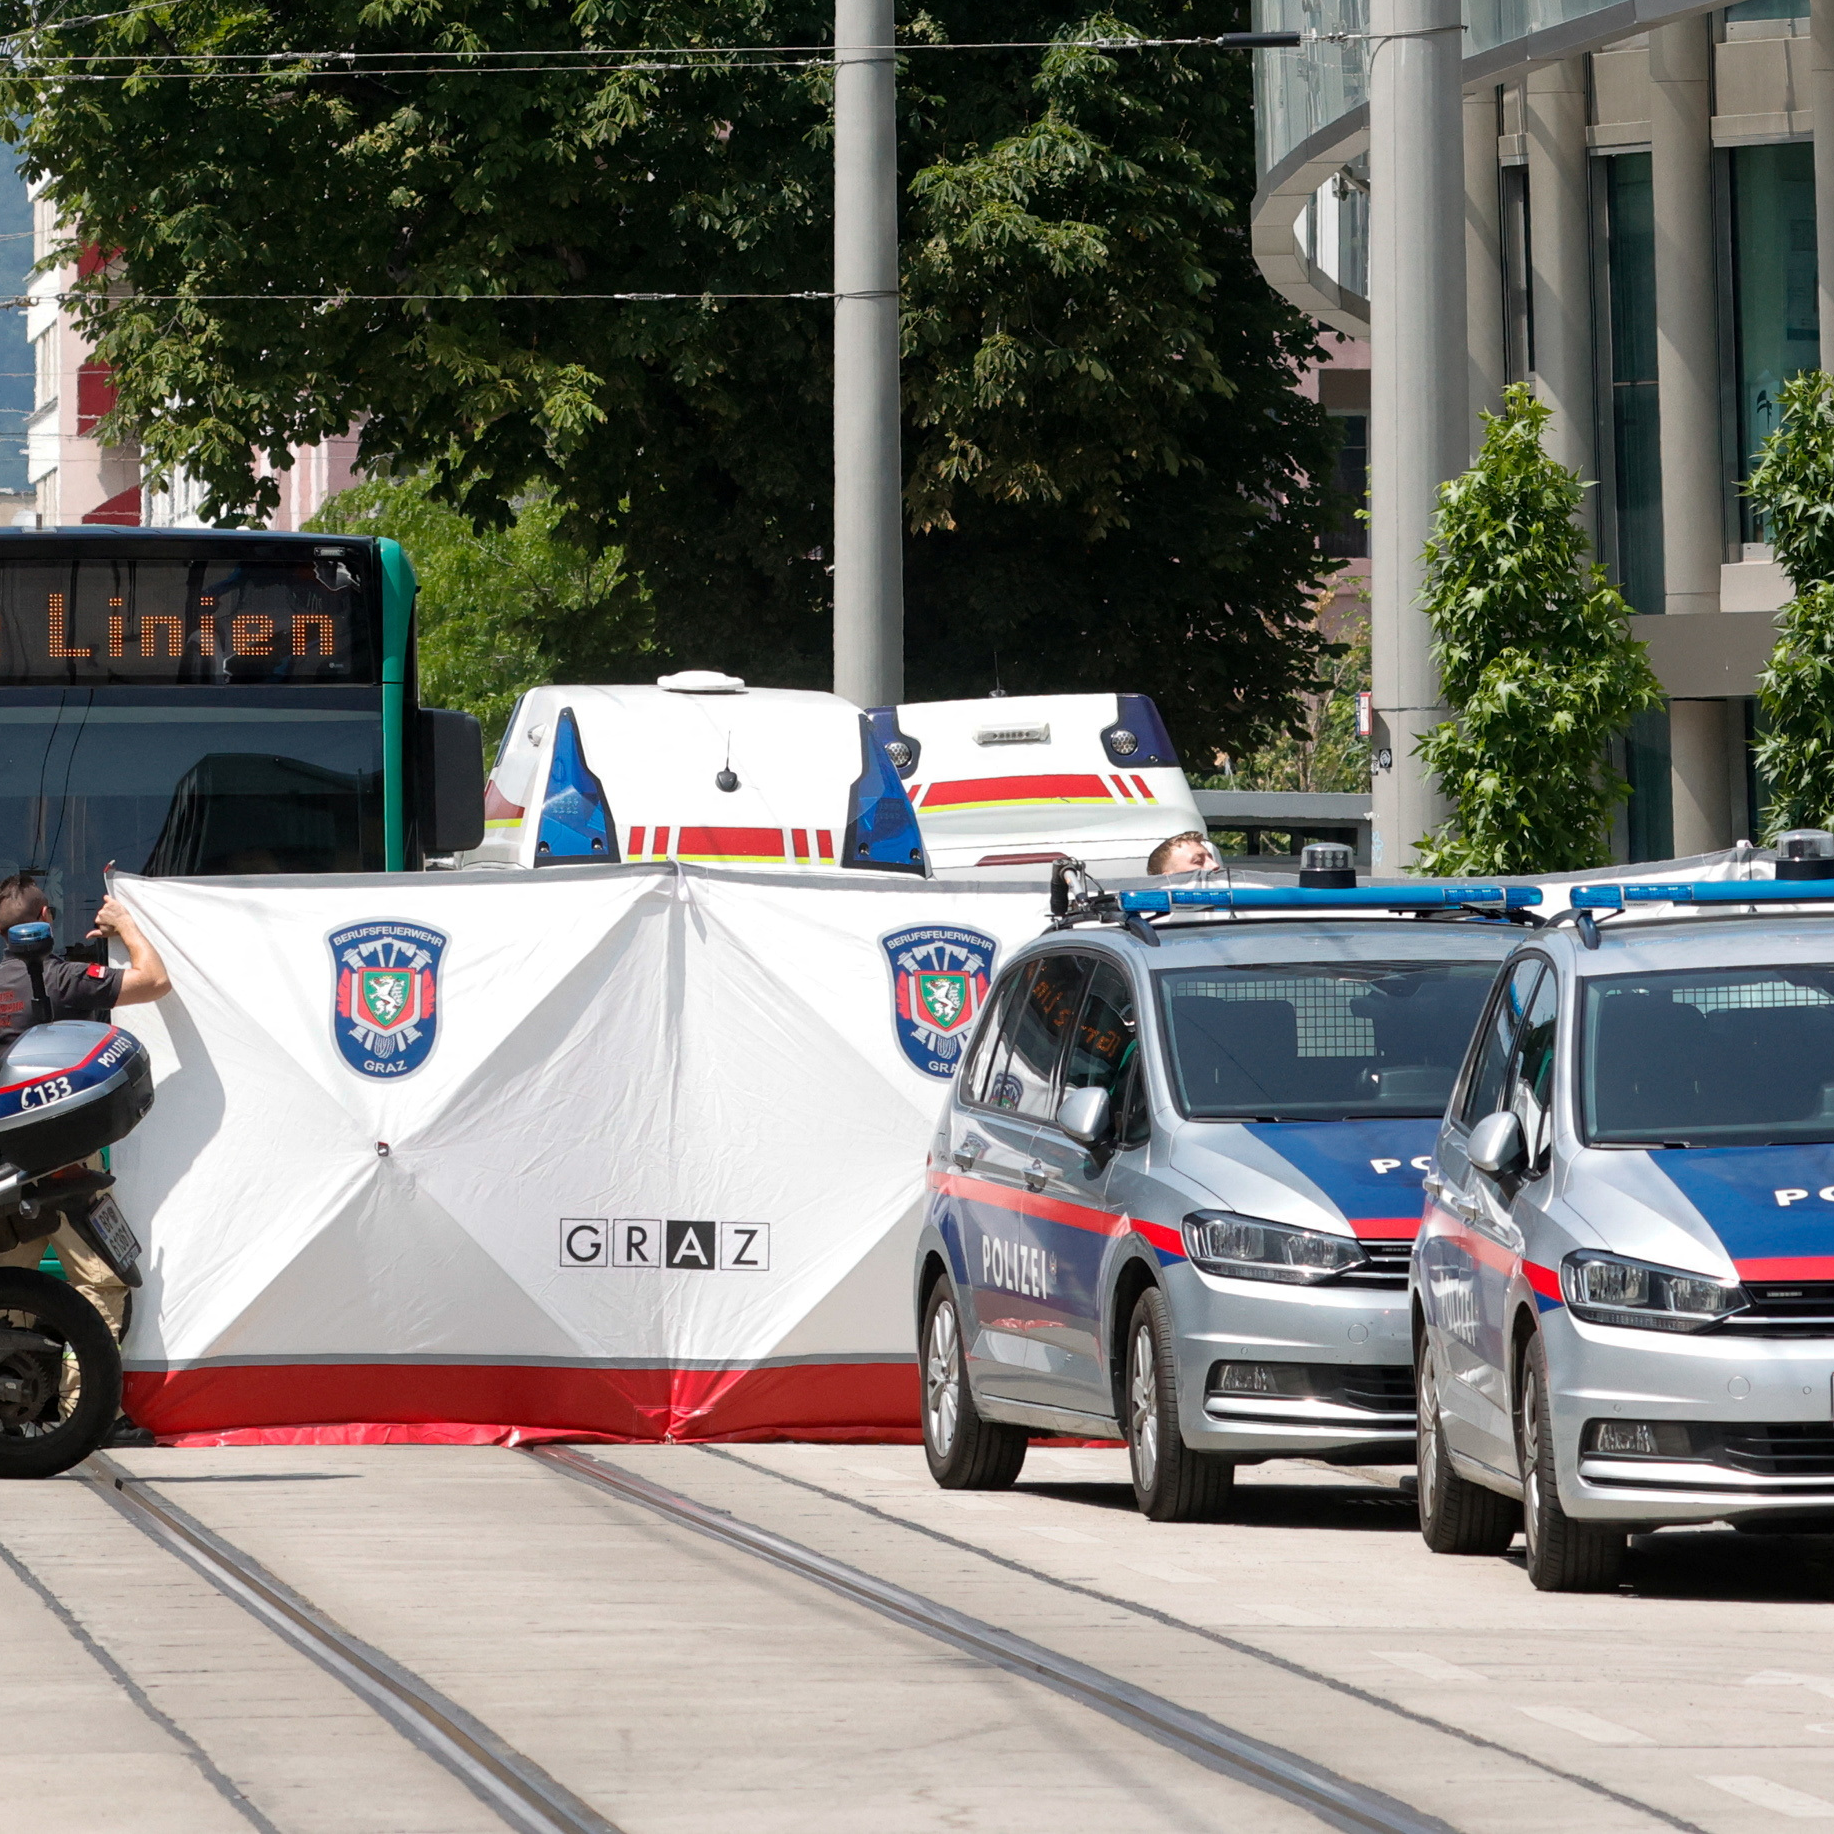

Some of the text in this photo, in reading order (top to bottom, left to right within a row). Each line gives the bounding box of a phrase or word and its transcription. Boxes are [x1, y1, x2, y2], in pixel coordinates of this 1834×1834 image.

[48, 594, 334, 658] Linien
[333, 926, 443, 947] BERUFSFEUERWEHR
[886, 930, 993, 951] BERUFSFEUERWEHR
[97, 1034, 133, 1068] POLIZEI
[364, 1059, 408, 1073] GRAZ
[928, 1060, 958, 1074] GRA
[33, 1076, 73, 1106] 133
[566, 1224, 759, 1266] GRAZ
[982, 1234, 1047, 1300] POLIZEI
